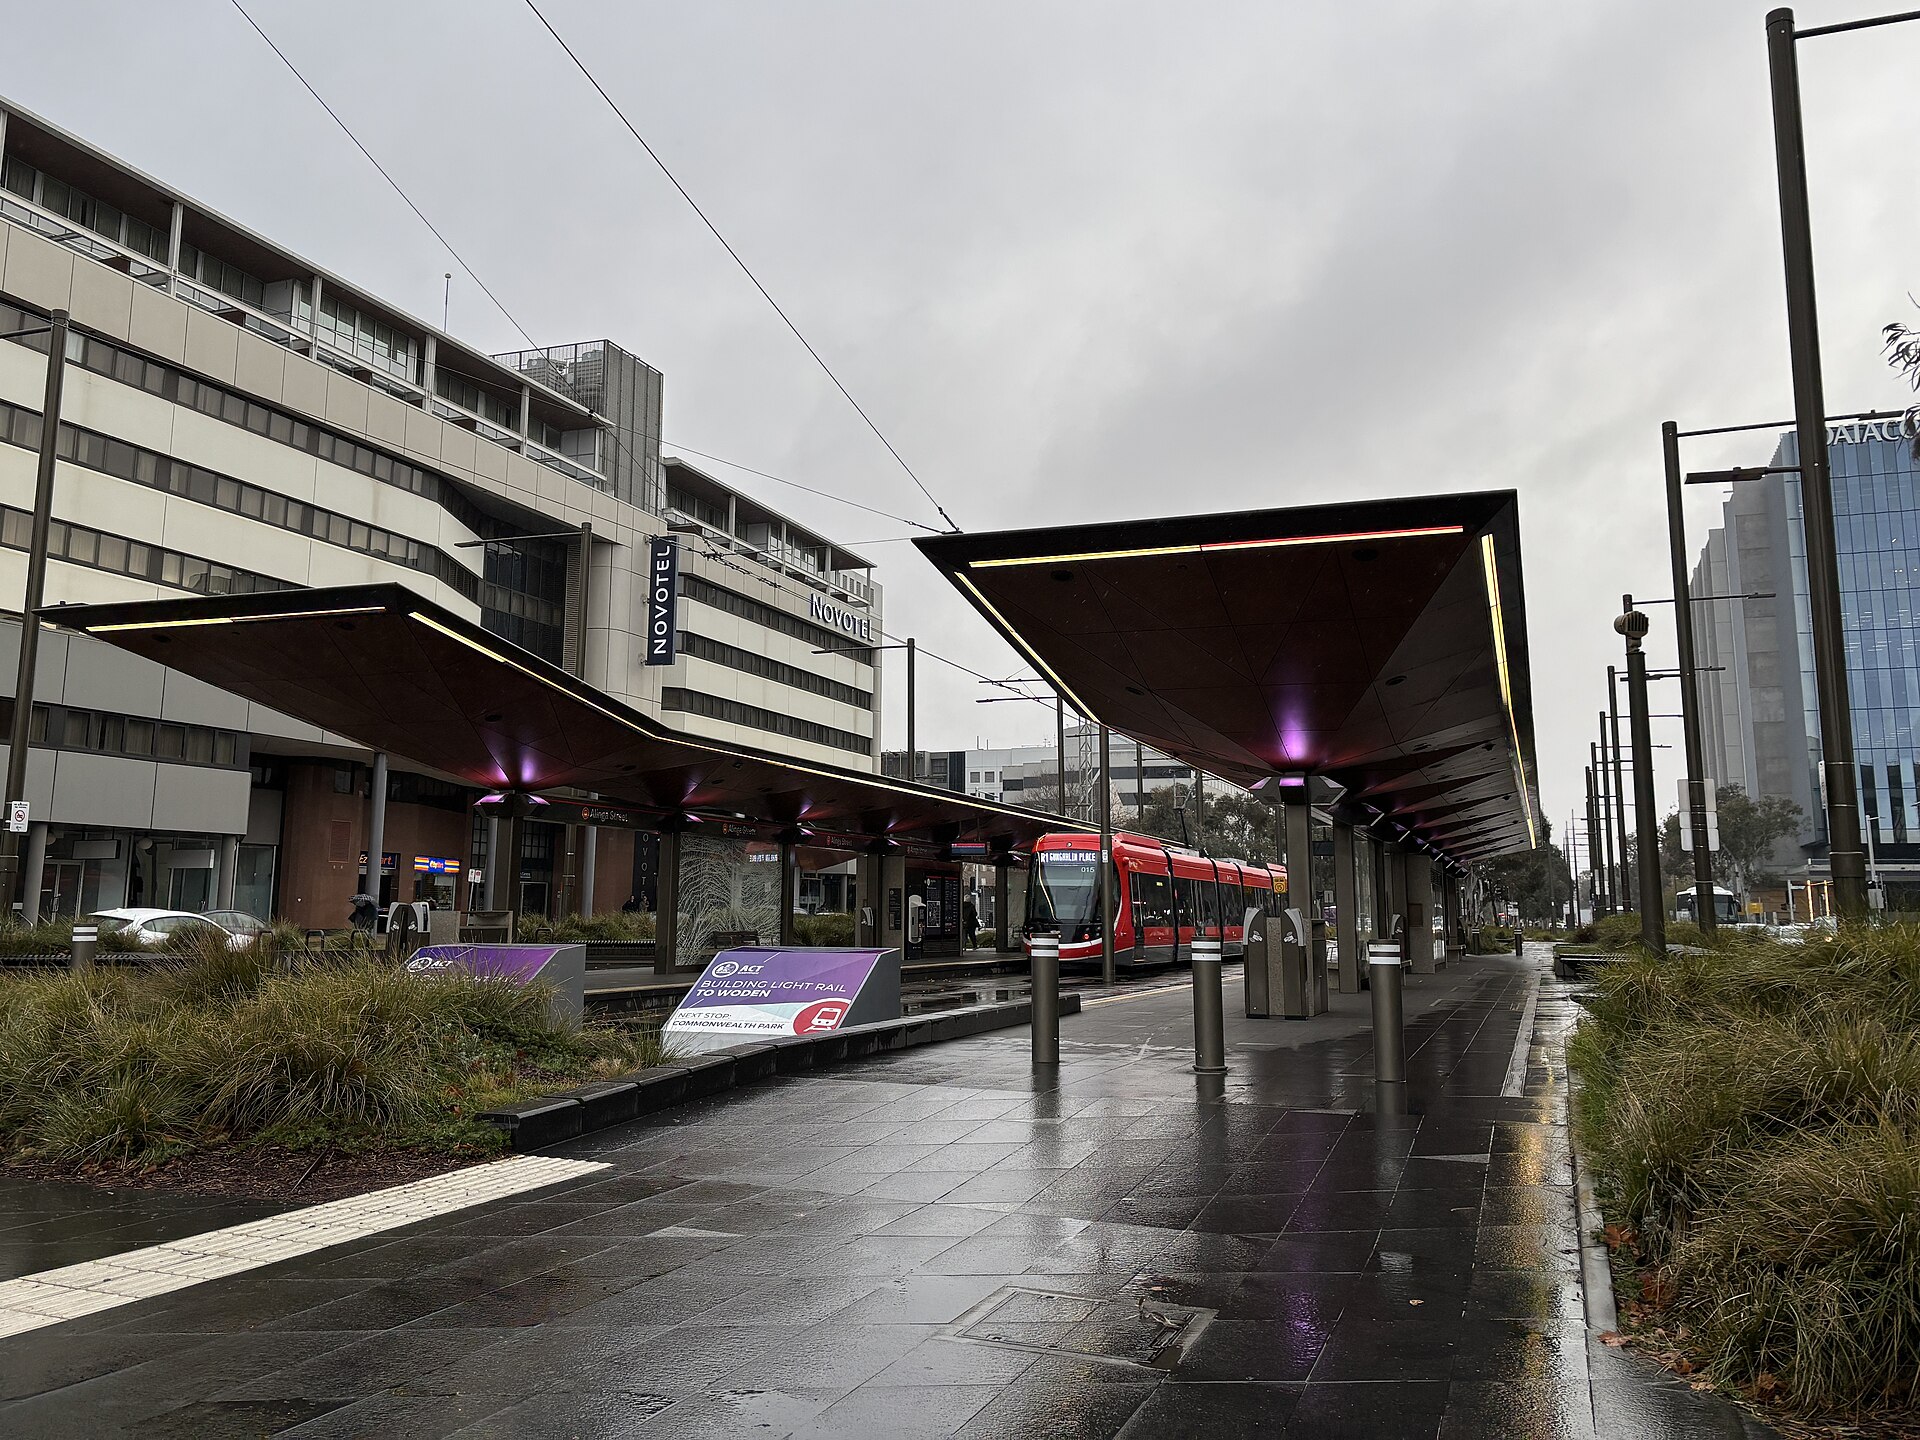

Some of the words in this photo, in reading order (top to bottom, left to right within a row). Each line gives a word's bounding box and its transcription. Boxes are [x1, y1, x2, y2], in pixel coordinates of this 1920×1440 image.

[653, 545, 670, 655] NOVOTEL
[811, 593, 876, 642] NOVOTEL
[590, 808, 609, 822] Alinga
[610, 810, 628, 822] Street
[1040, 852, 1049, 863] R1
[1079, 852, 1096, 862] PLACE
[640, 833, 649, 900] OVOTE
[701, 980, 769, 989] BUILDING
[770, 981, 813, 990] LIGHT
[815, 983, 847, 993] RAIL
[695, 989, 715, 997] TO
[717, 989, 771, 998] WODEN
[672, 1020, 757, 1029] COMMONWEALTH
